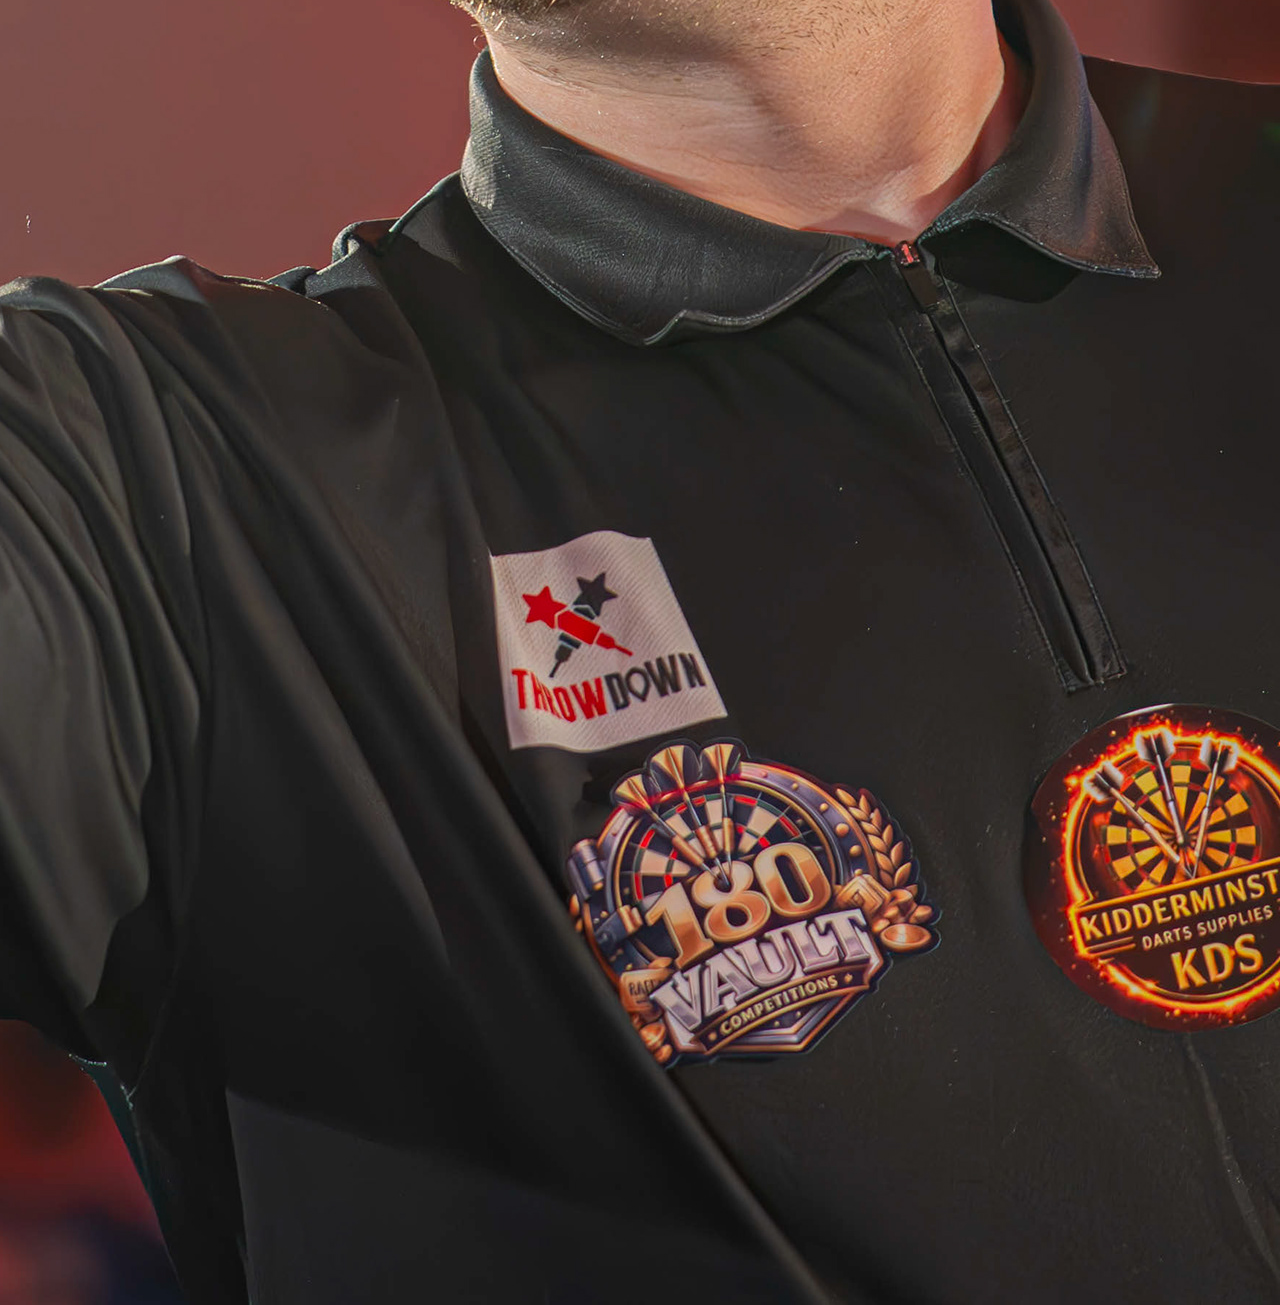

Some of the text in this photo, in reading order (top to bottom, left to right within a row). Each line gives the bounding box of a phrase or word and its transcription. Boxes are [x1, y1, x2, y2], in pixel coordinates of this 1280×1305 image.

[644, 842, 832, 969] 180
[1141, 905, 1274, 950] DARTS SUPPLIES
[650, 909, 870, 1031] VAULT
[1171, 934, 1264, 990] KDS
[720, 975, 839, 1033] COMPETITIONS
